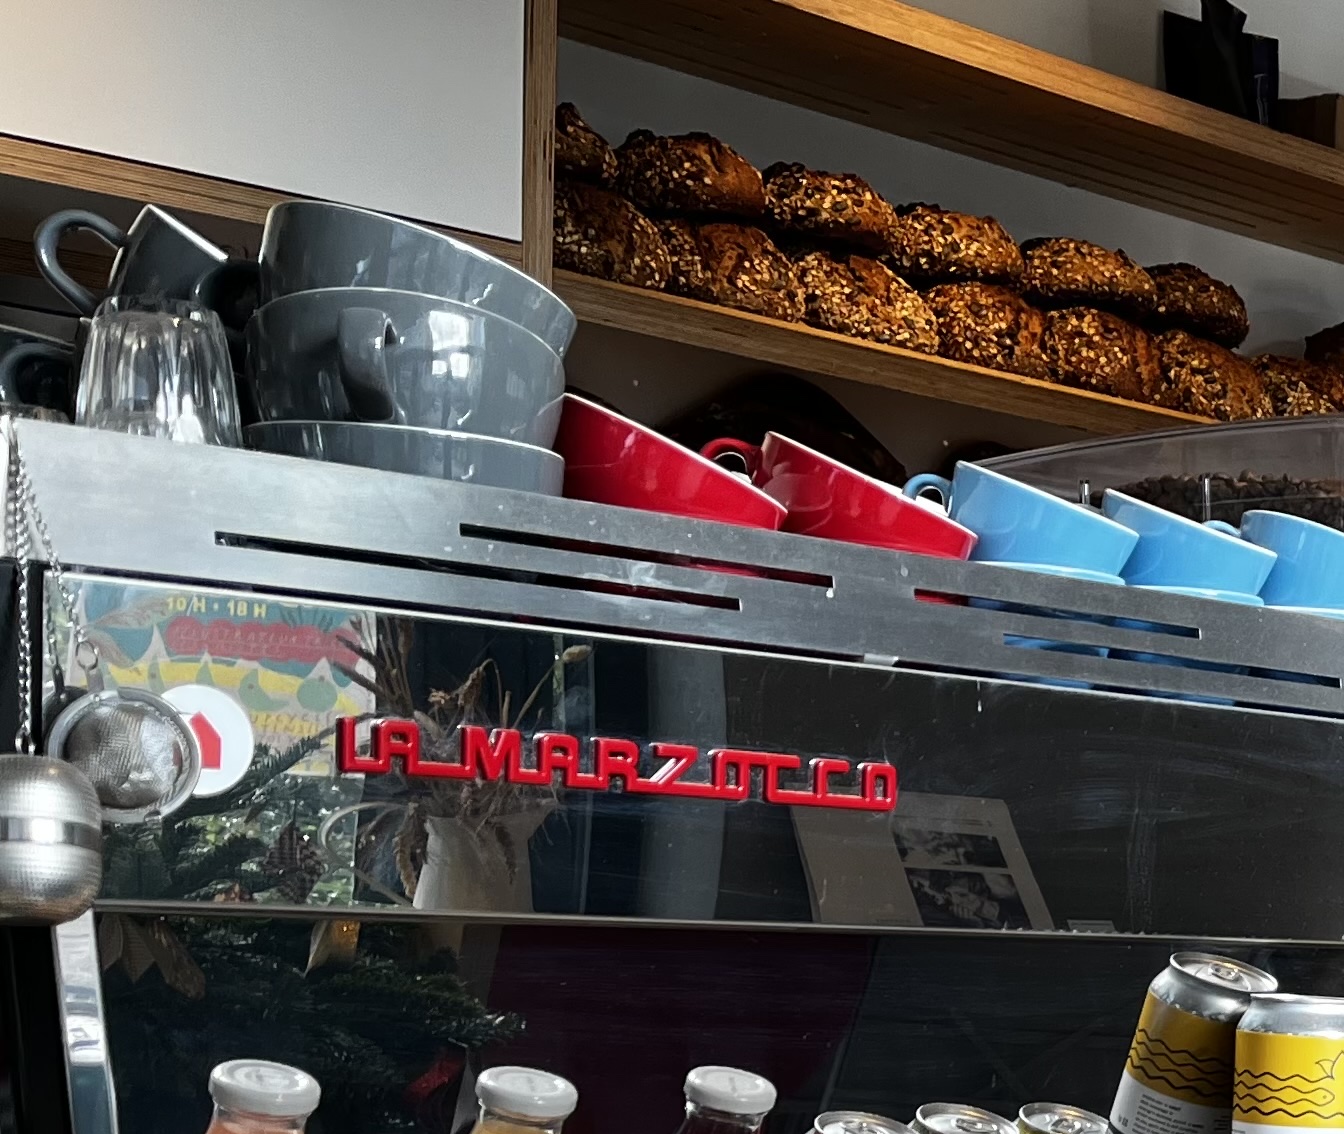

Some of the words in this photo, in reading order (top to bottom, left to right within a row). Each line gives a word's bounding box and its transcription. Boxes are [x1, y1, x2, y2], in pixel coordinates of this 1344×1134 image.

[167, 597, 187, 611] 10
[192, 598, 206, 613] H
[227, 600, 248, 616] 18
[254, 602, 267, 618] H
[334, 715, 422, 777] LA
